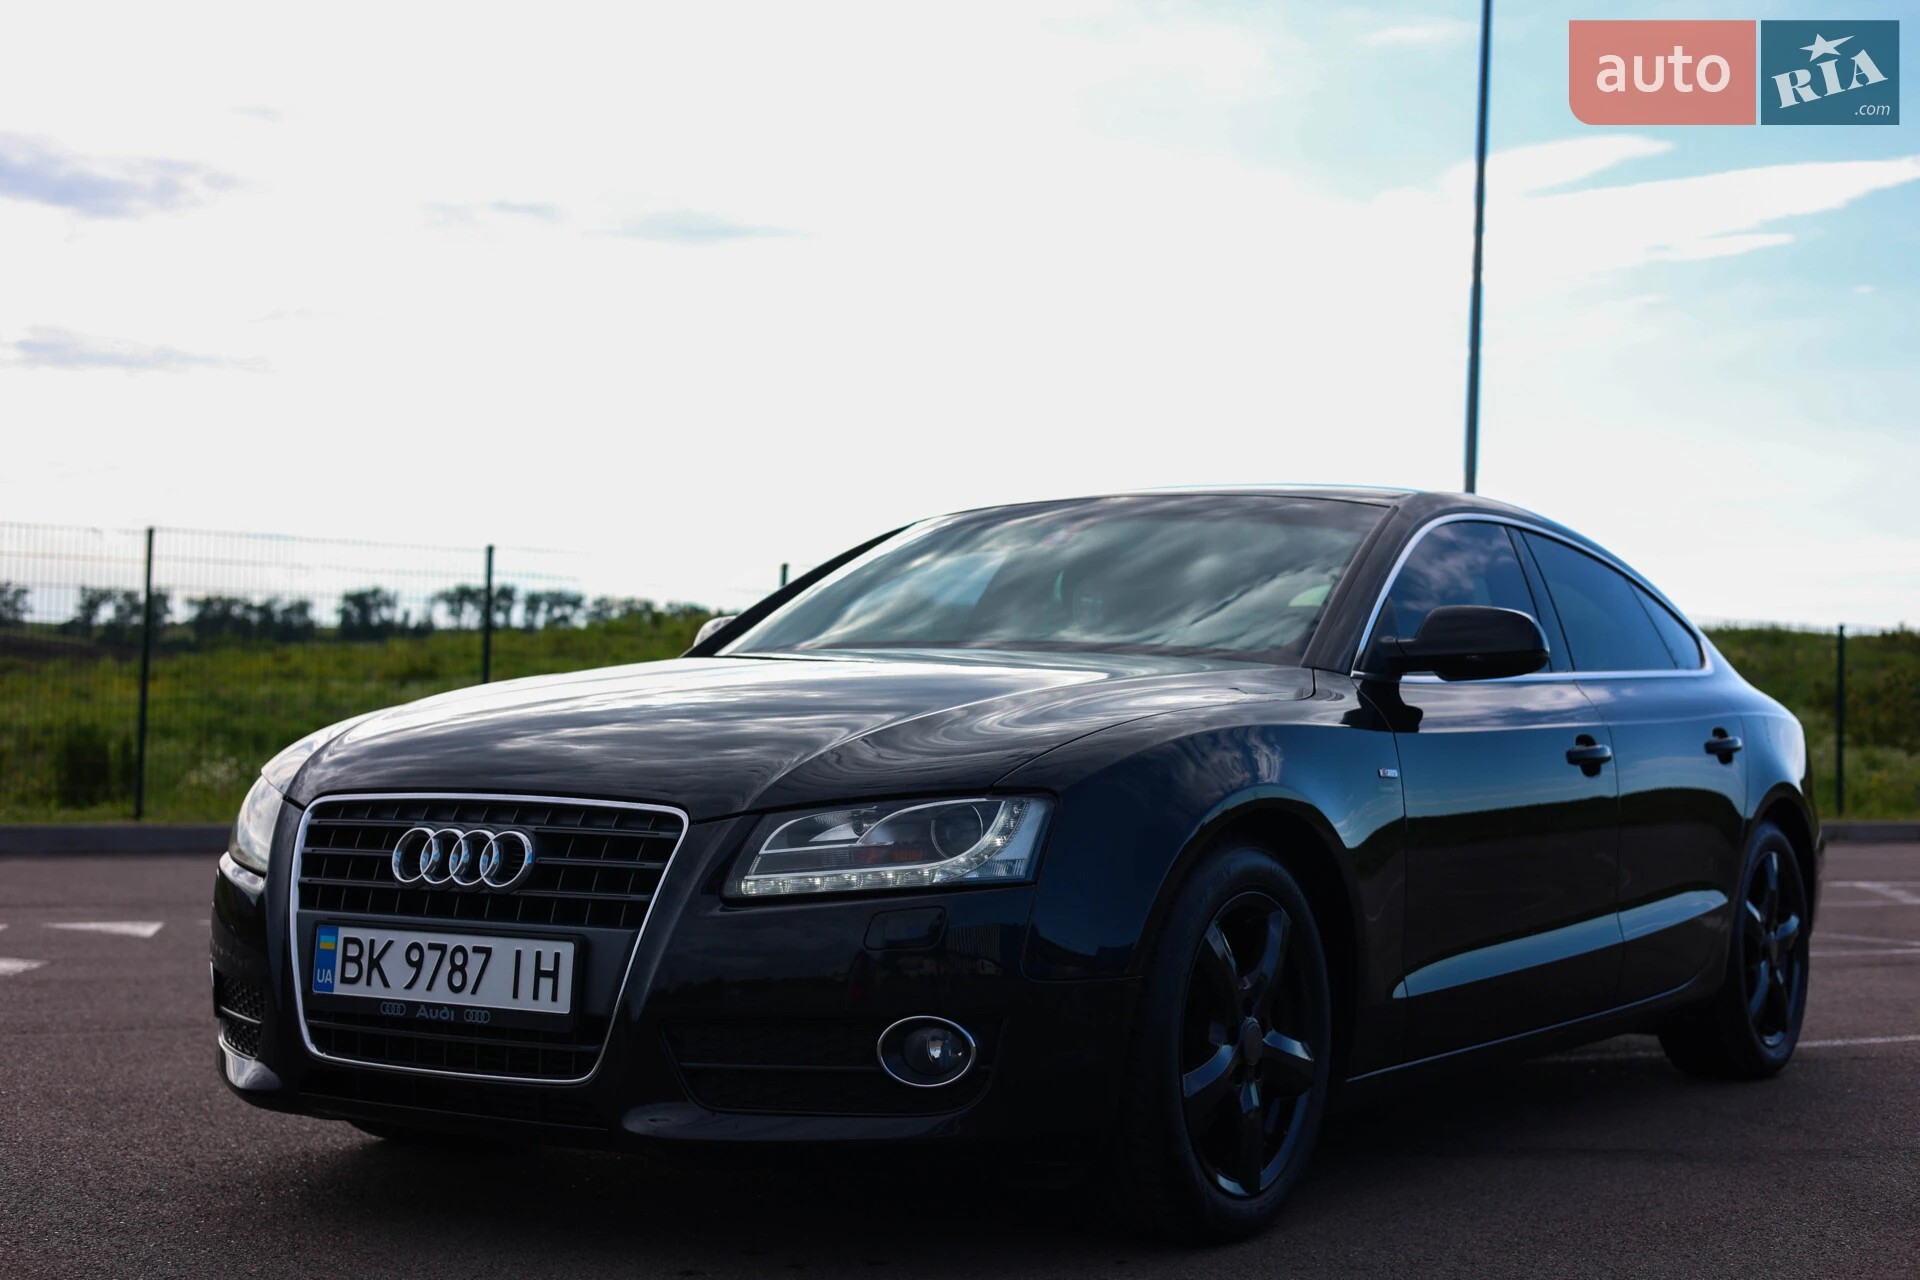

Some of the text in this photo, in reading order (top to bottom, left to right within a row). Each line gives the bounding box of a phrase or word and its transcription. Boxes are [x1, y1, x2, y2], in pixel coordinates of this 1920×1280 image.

[316, 968, 333, 984] UA
[339, 936, 561, 1002] BK 9787 IH
[415, 1004, 455, 1021] Audi
